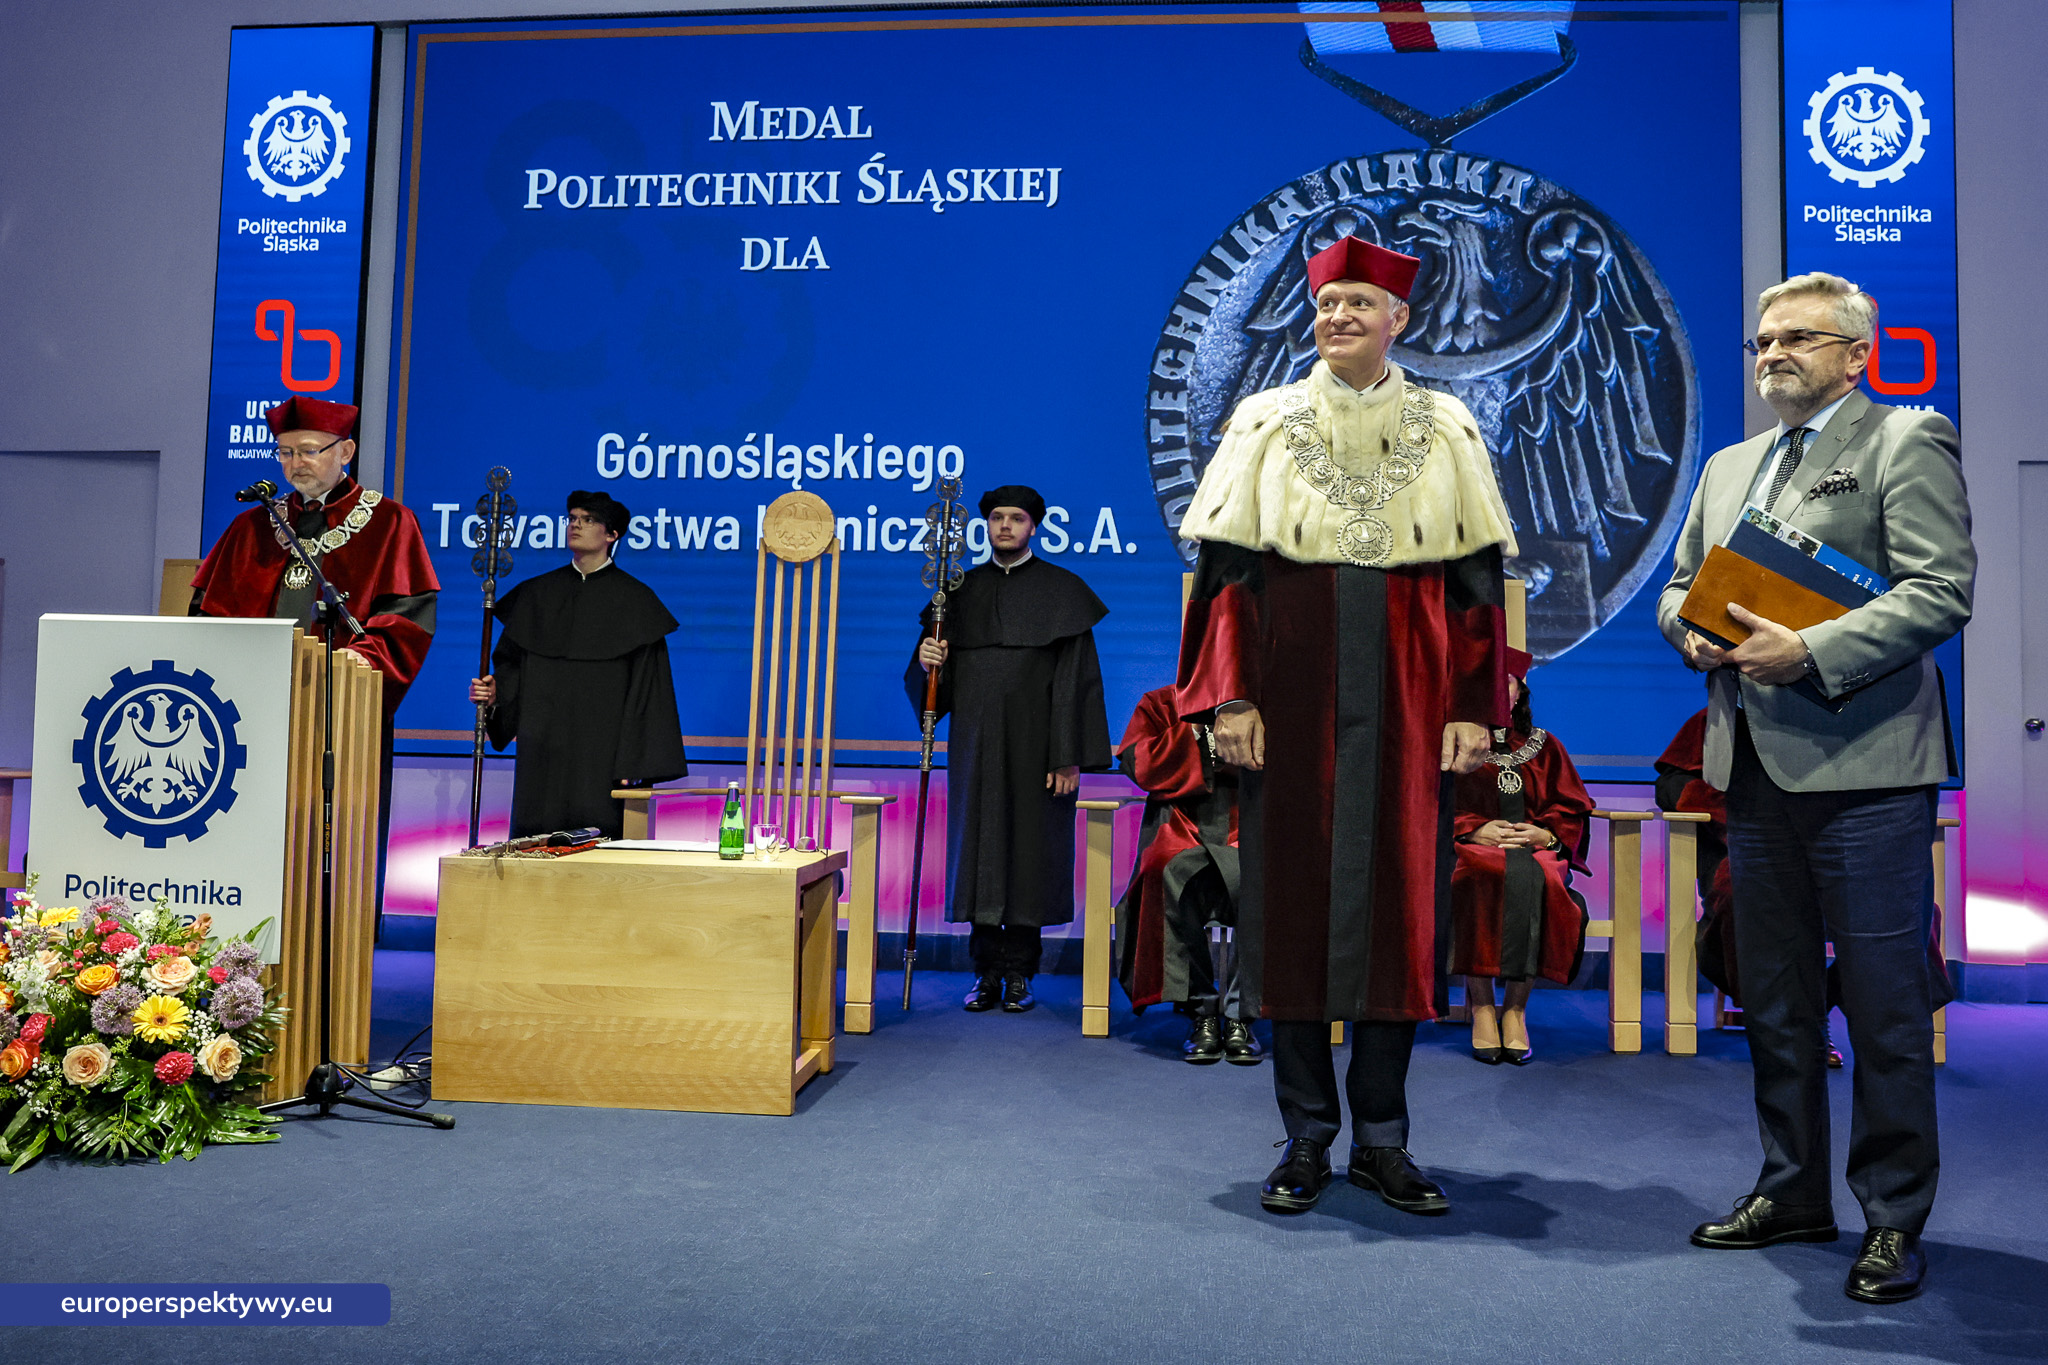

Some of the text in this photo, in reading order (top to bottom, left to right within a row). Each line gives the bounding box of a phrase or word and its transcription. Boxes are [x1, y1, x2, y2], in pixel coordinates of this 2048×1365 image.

[709, 100, 872, 141] MEDAL
[524, 152, 1062, 213] POLITECHNIKI ŚLĄSKIEJ
[238, 217, 347, 235] Politechnika
[1804, 204, 1932, 223] Politechnika
[263, 232, 320, 254] Śląska
[1835, 221, 1902, 244] Śląska
[740, 236, 831, 271] DLA
[596, 432, 966, 491] Górnośląskiego
[432, 503, 740, 558] Towarstwa
[1040, 506, 1138, 554] S.A.
[65, 874, 242, 906] Politechnika
